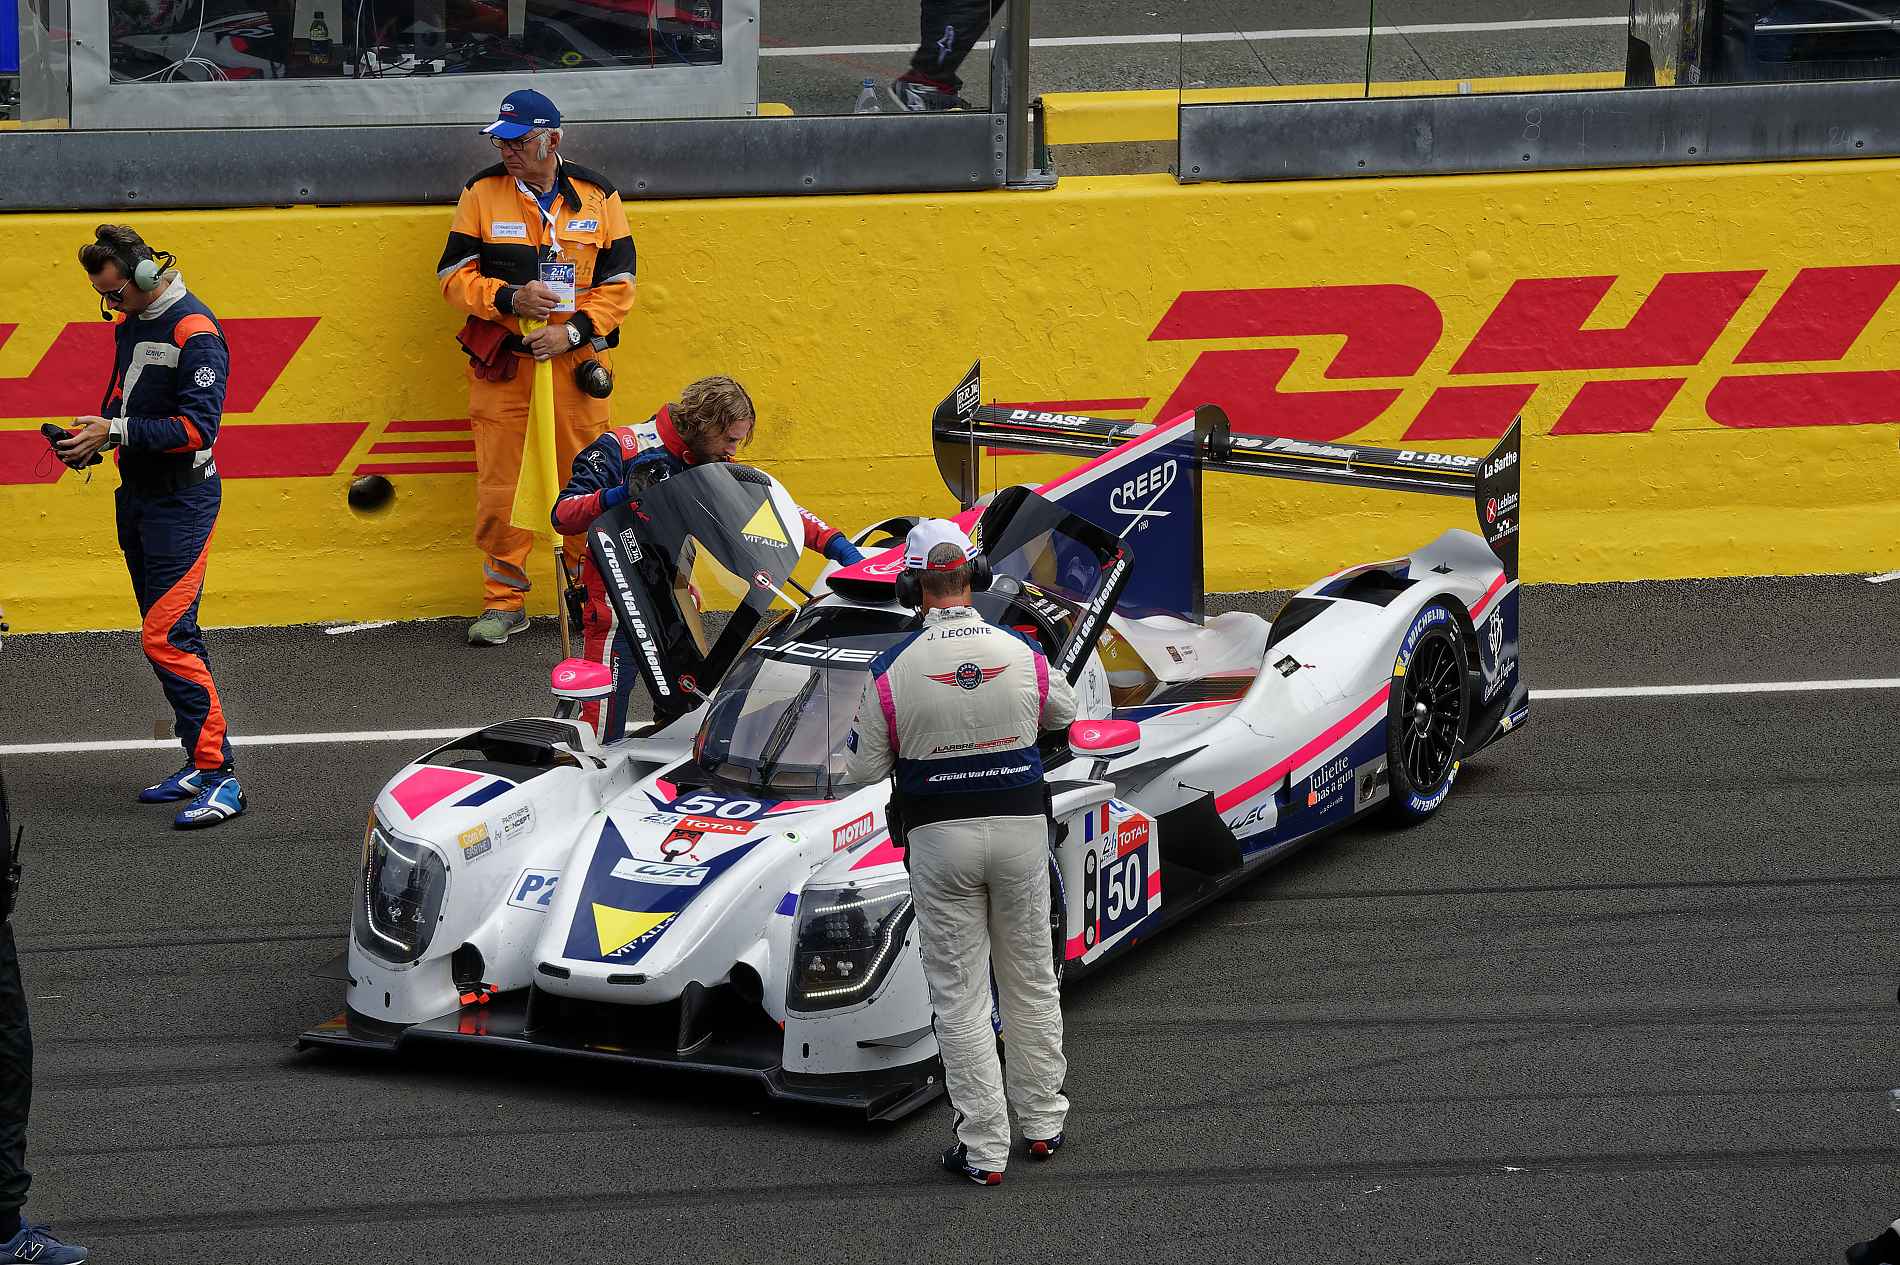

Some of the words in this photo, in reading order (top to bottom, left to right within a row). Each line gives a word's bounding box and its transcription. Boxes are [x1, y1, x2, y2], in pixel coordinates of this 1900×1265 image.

[1147, 264, 1900, 442] DHL
[1036, 412, 1090, 426] BASF
[1424, 453, 1479, 466] BASF
[1484, 463, 1494, 479] La
[1494, 451, 1518, 474] Sarthe
[1110, 459, 1177, 526] CREED
[1497, 492, 1518, 511] Leblanc
[597, 531, 629, 590] Circuit
[620, 590, 642, 618] Val
[631, 618, 648, 639] de
[640, 634, 671, 697] Vienne
[1065, 635, 1085, 664] Val
[1081, 614, 1095, 638] de
[1091, 559, 1126, 615] Vienne
[941, 626, 992, 639] LECONTE
[1407, 610, 1445, 650] MICHELIN
[751, 636, 885, 664] LIGIE
[968, 770, 985, 779] Val
[986, 767, 999, 777] de
[1310, 756, 1349, 794] Juliette
[1331, 782, 1336, 793] a
[1337, 769, 1354, 791] gun
[674, 795, 762, 819] 50
[1410, 783, 1450, 812] MICHELIN
[685, 818, 748, 833] TOTAL
[834, 815, 873, 849] MOTUL
[1118, 823, 1148, 847] TOTAL
[515, 873, 560, 906] P2
[1106, 852, 1142, 922] 50
